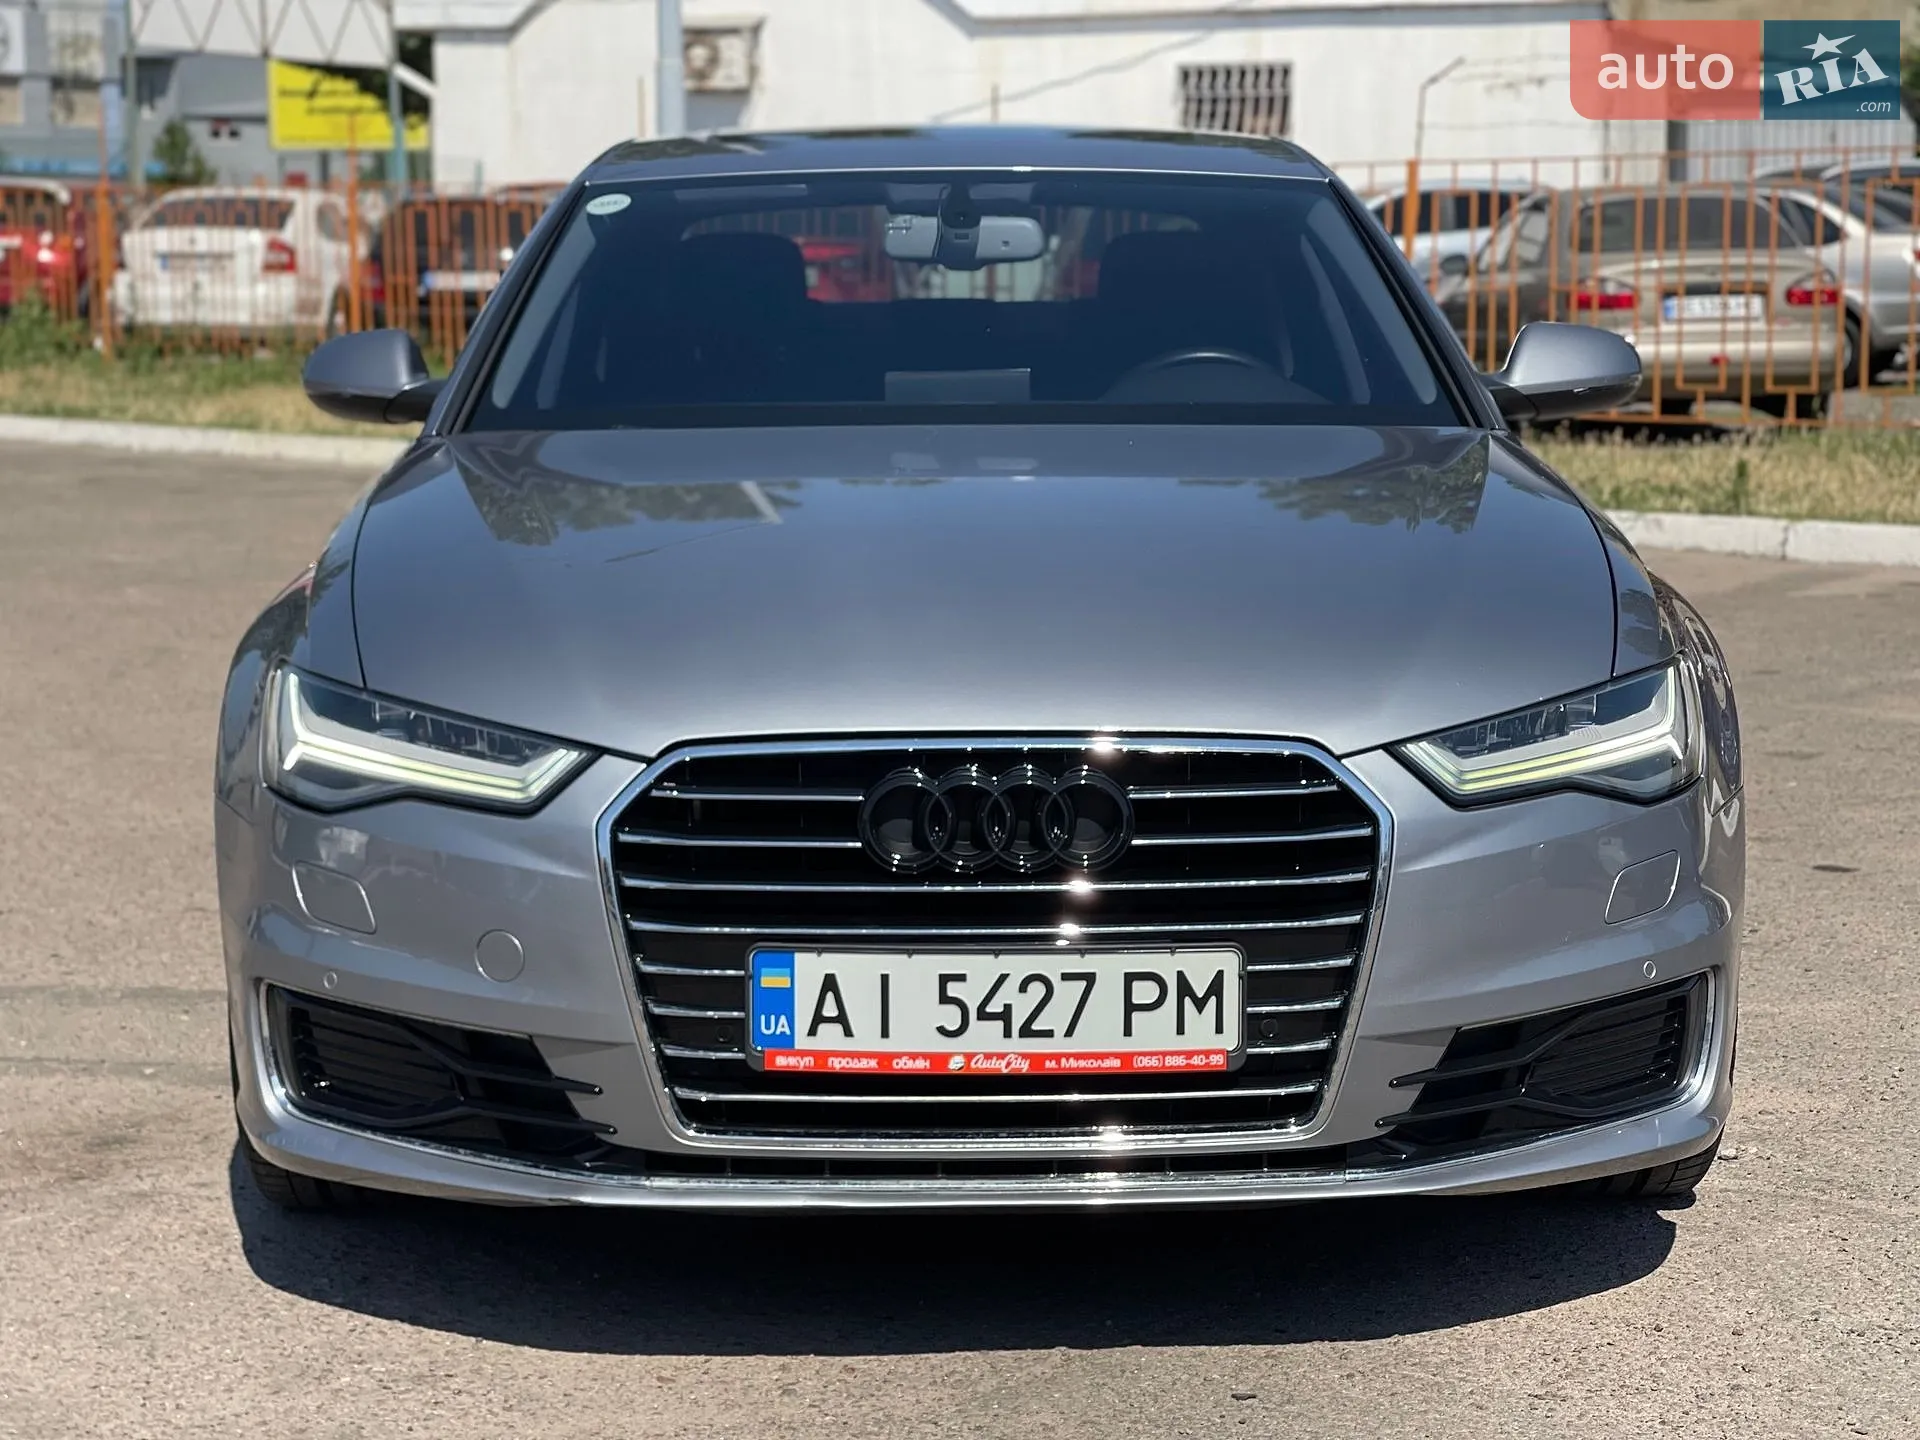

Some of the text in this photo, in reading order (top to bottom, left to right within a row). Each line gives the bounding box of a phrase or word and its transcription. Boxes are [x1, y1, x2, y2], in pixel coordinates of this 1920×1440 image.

[935, 972, 1097, 1038] 5427
[1123, 969, 1224, 1037] PM
[760, 1014, 791, 1036] UA
[775, 1055, 814, 1069] викуп
[827, 1055, 879, 1069] продаж
[892, 1055, 930, 1069] обмін
[1061, 1056, 1121, 1069] Миколаїв
[1164, 1054, 1224, 1067] 886-40-99
